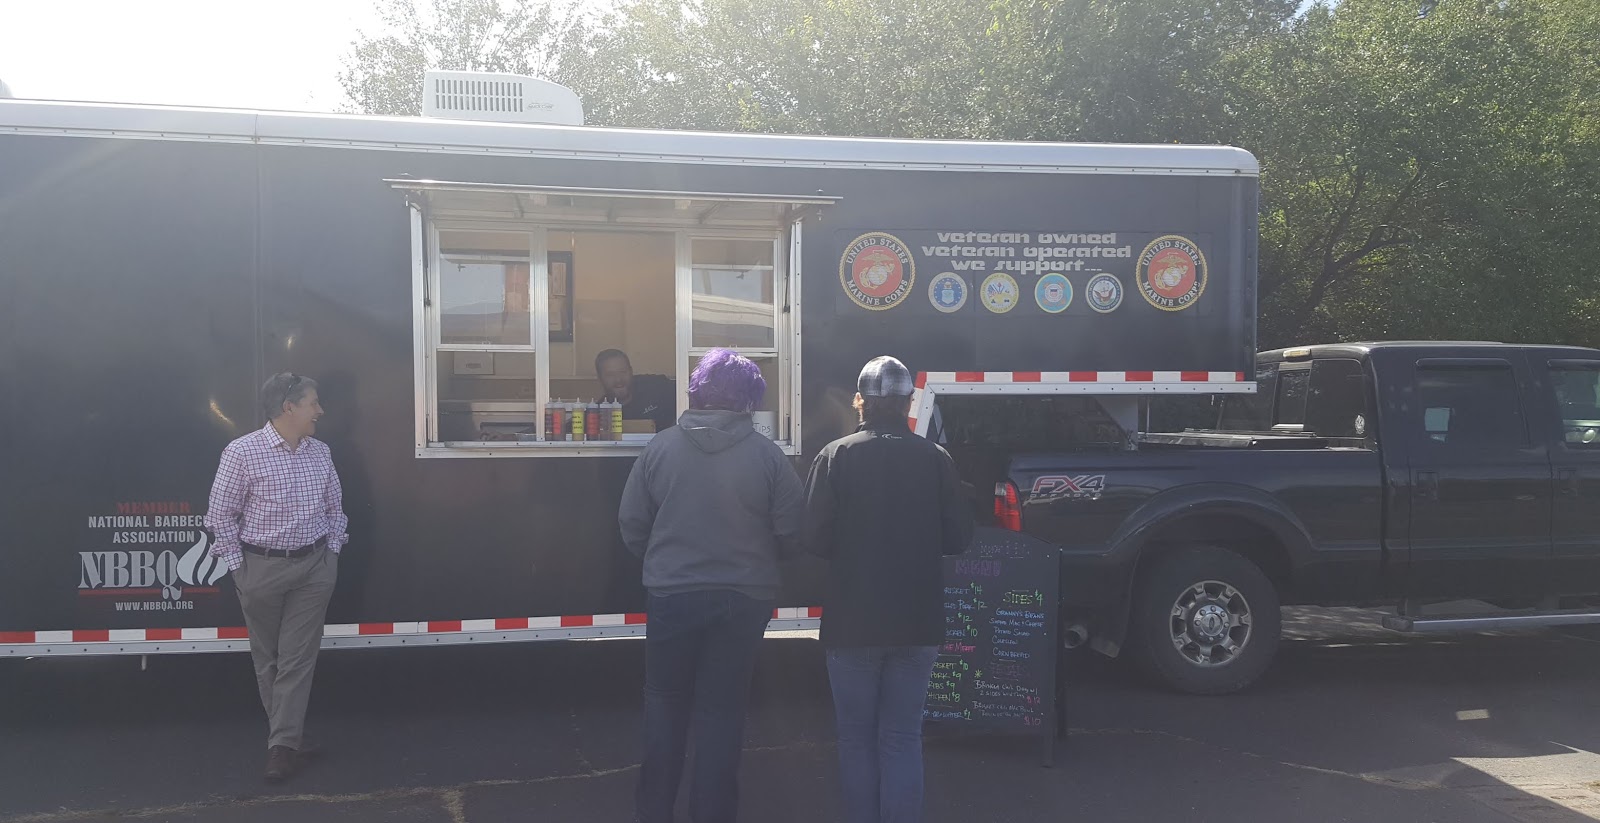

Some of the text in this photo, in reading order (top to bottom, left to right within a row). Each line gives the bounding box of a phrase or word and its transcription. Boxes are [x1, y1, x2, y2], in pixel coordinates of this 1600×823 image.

[846, 238, 908, 264] UNITED STATES
[1142, 241, 1201, 266] UNITED STATES
[847, 279, 880, 305] MARINE
[885, 280, 908, 303] CORPS
[1143, 281, 1174, 306] MARINE
[1178, 281, 1201, 304] CORPS
[1031, 475, 1105, 493] FX4
[117, 502, 191, 514] MEMBER
[88, 515, 207, 528] NATIONAL BARBEC
[113, 531, 195, 544] ASSOCIATION
[78, 550, 182, 600] NBBQ
[970, 582, 983, 595] $14
[973, 597, 988, 611] $12
[1003, 589, 1043, 606] SIDES $4
[115, 601, 194, 611] WWW.NBBQA.ORG
[958, 612, 972, 623] $12
[966, 624, 978, 637] $10
[952, 671, 962, 681] $9
[945, 680, 956, 691] $9
[926, 691, 961, 702] HICKEN $8
